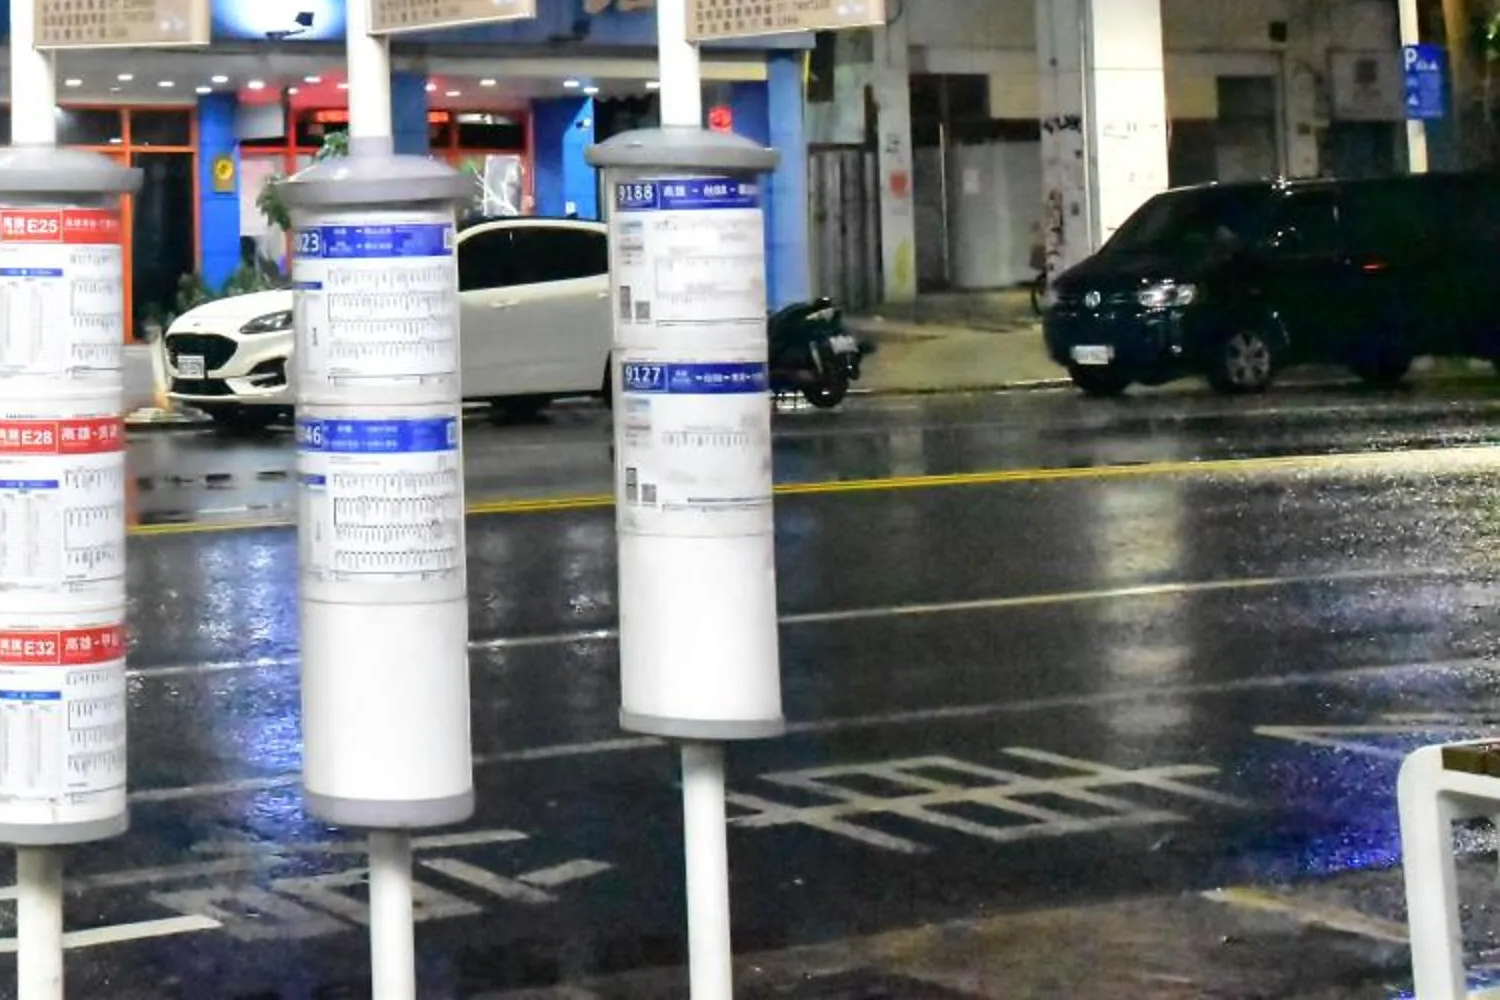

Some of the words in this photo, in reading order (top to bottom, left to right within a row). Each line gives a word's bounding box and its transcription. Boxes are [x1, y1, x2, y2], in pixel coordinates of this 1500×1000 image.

[618, 184, 654, 201] 9188
[27, 218, 58, 234] E25
[624, 365, 661, 384] 9127
[22, 429, 53, 445] E28
[23, 640, 56, 657] E32
